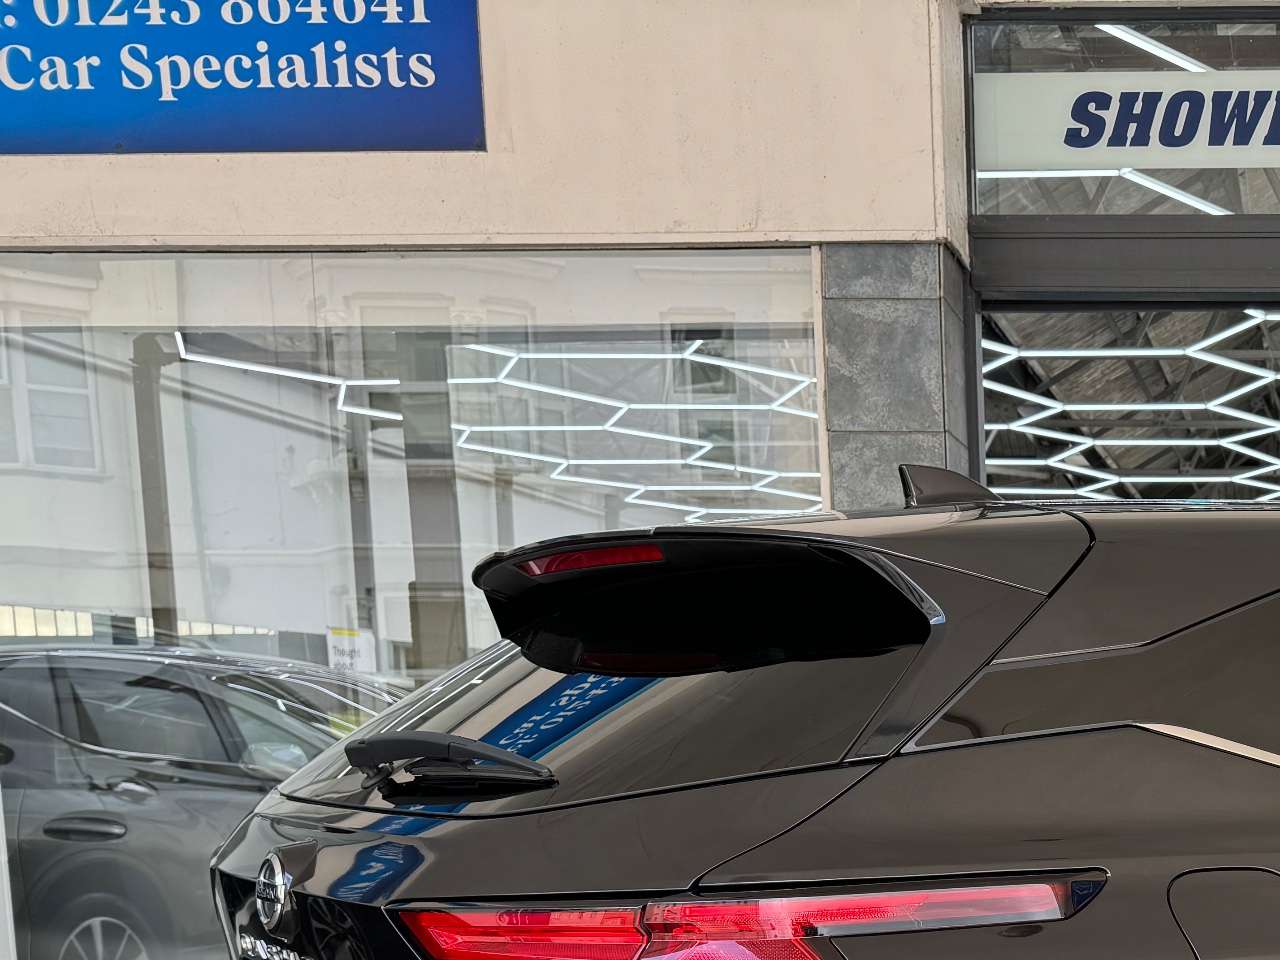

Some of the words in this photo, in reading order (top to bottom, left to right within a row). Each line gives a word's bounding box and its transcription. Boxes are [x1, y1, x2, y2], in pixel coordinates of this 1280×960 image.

[33, 0, 201, 26] 01243
[0, 44, 101, 91] Car
[120, 40, 436, 101] Specialists
